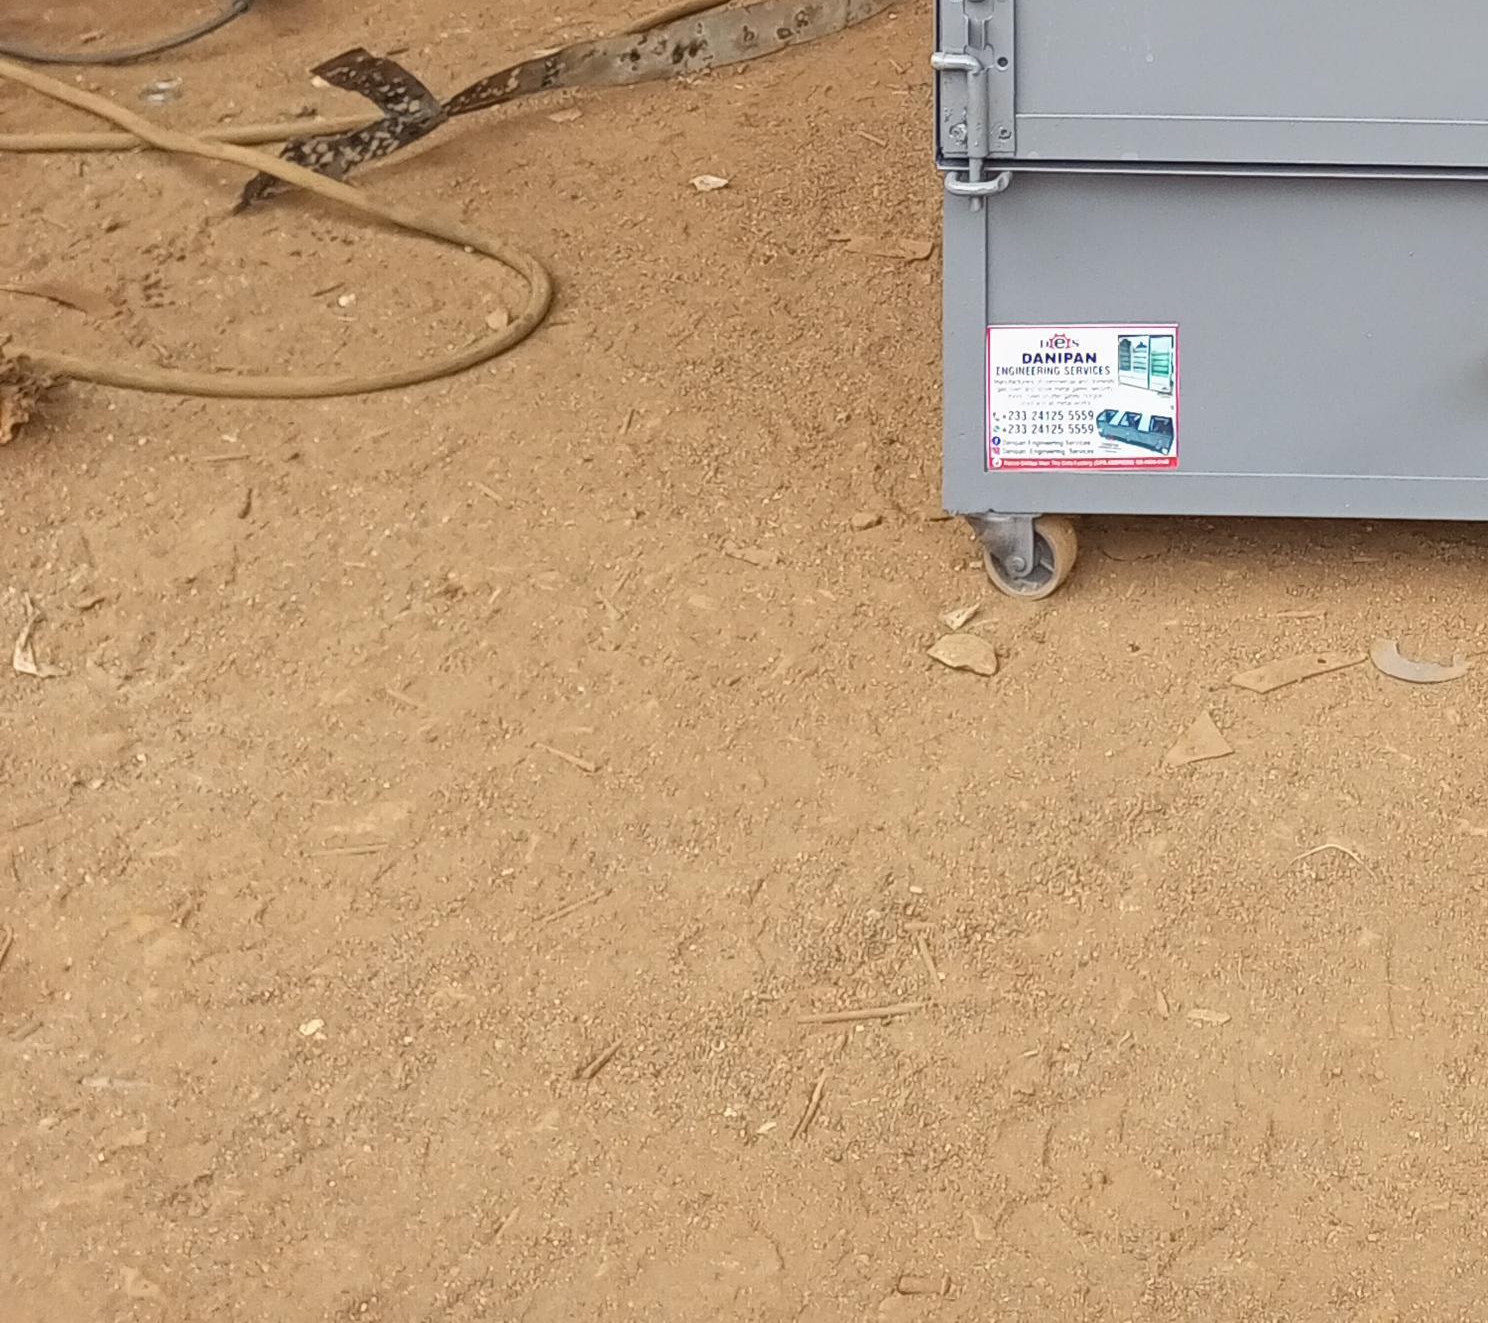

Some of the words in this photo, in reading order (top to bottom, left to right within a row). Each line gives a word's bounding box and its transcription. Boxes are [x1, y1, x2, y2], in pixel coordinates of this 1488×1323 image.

[1022, 352, 1097, 364] DANIPAN
[996, 366, 1061, 376] ENGINEERING
[1064, 365, 1111, 375] SERVICES
[1031, 410, 1064, 421] 24125
[1068, 410, 1094, 421] 5559
[1031, 424, 1064, 434] 24125
[1068, 424, 1094, 434] 5559
